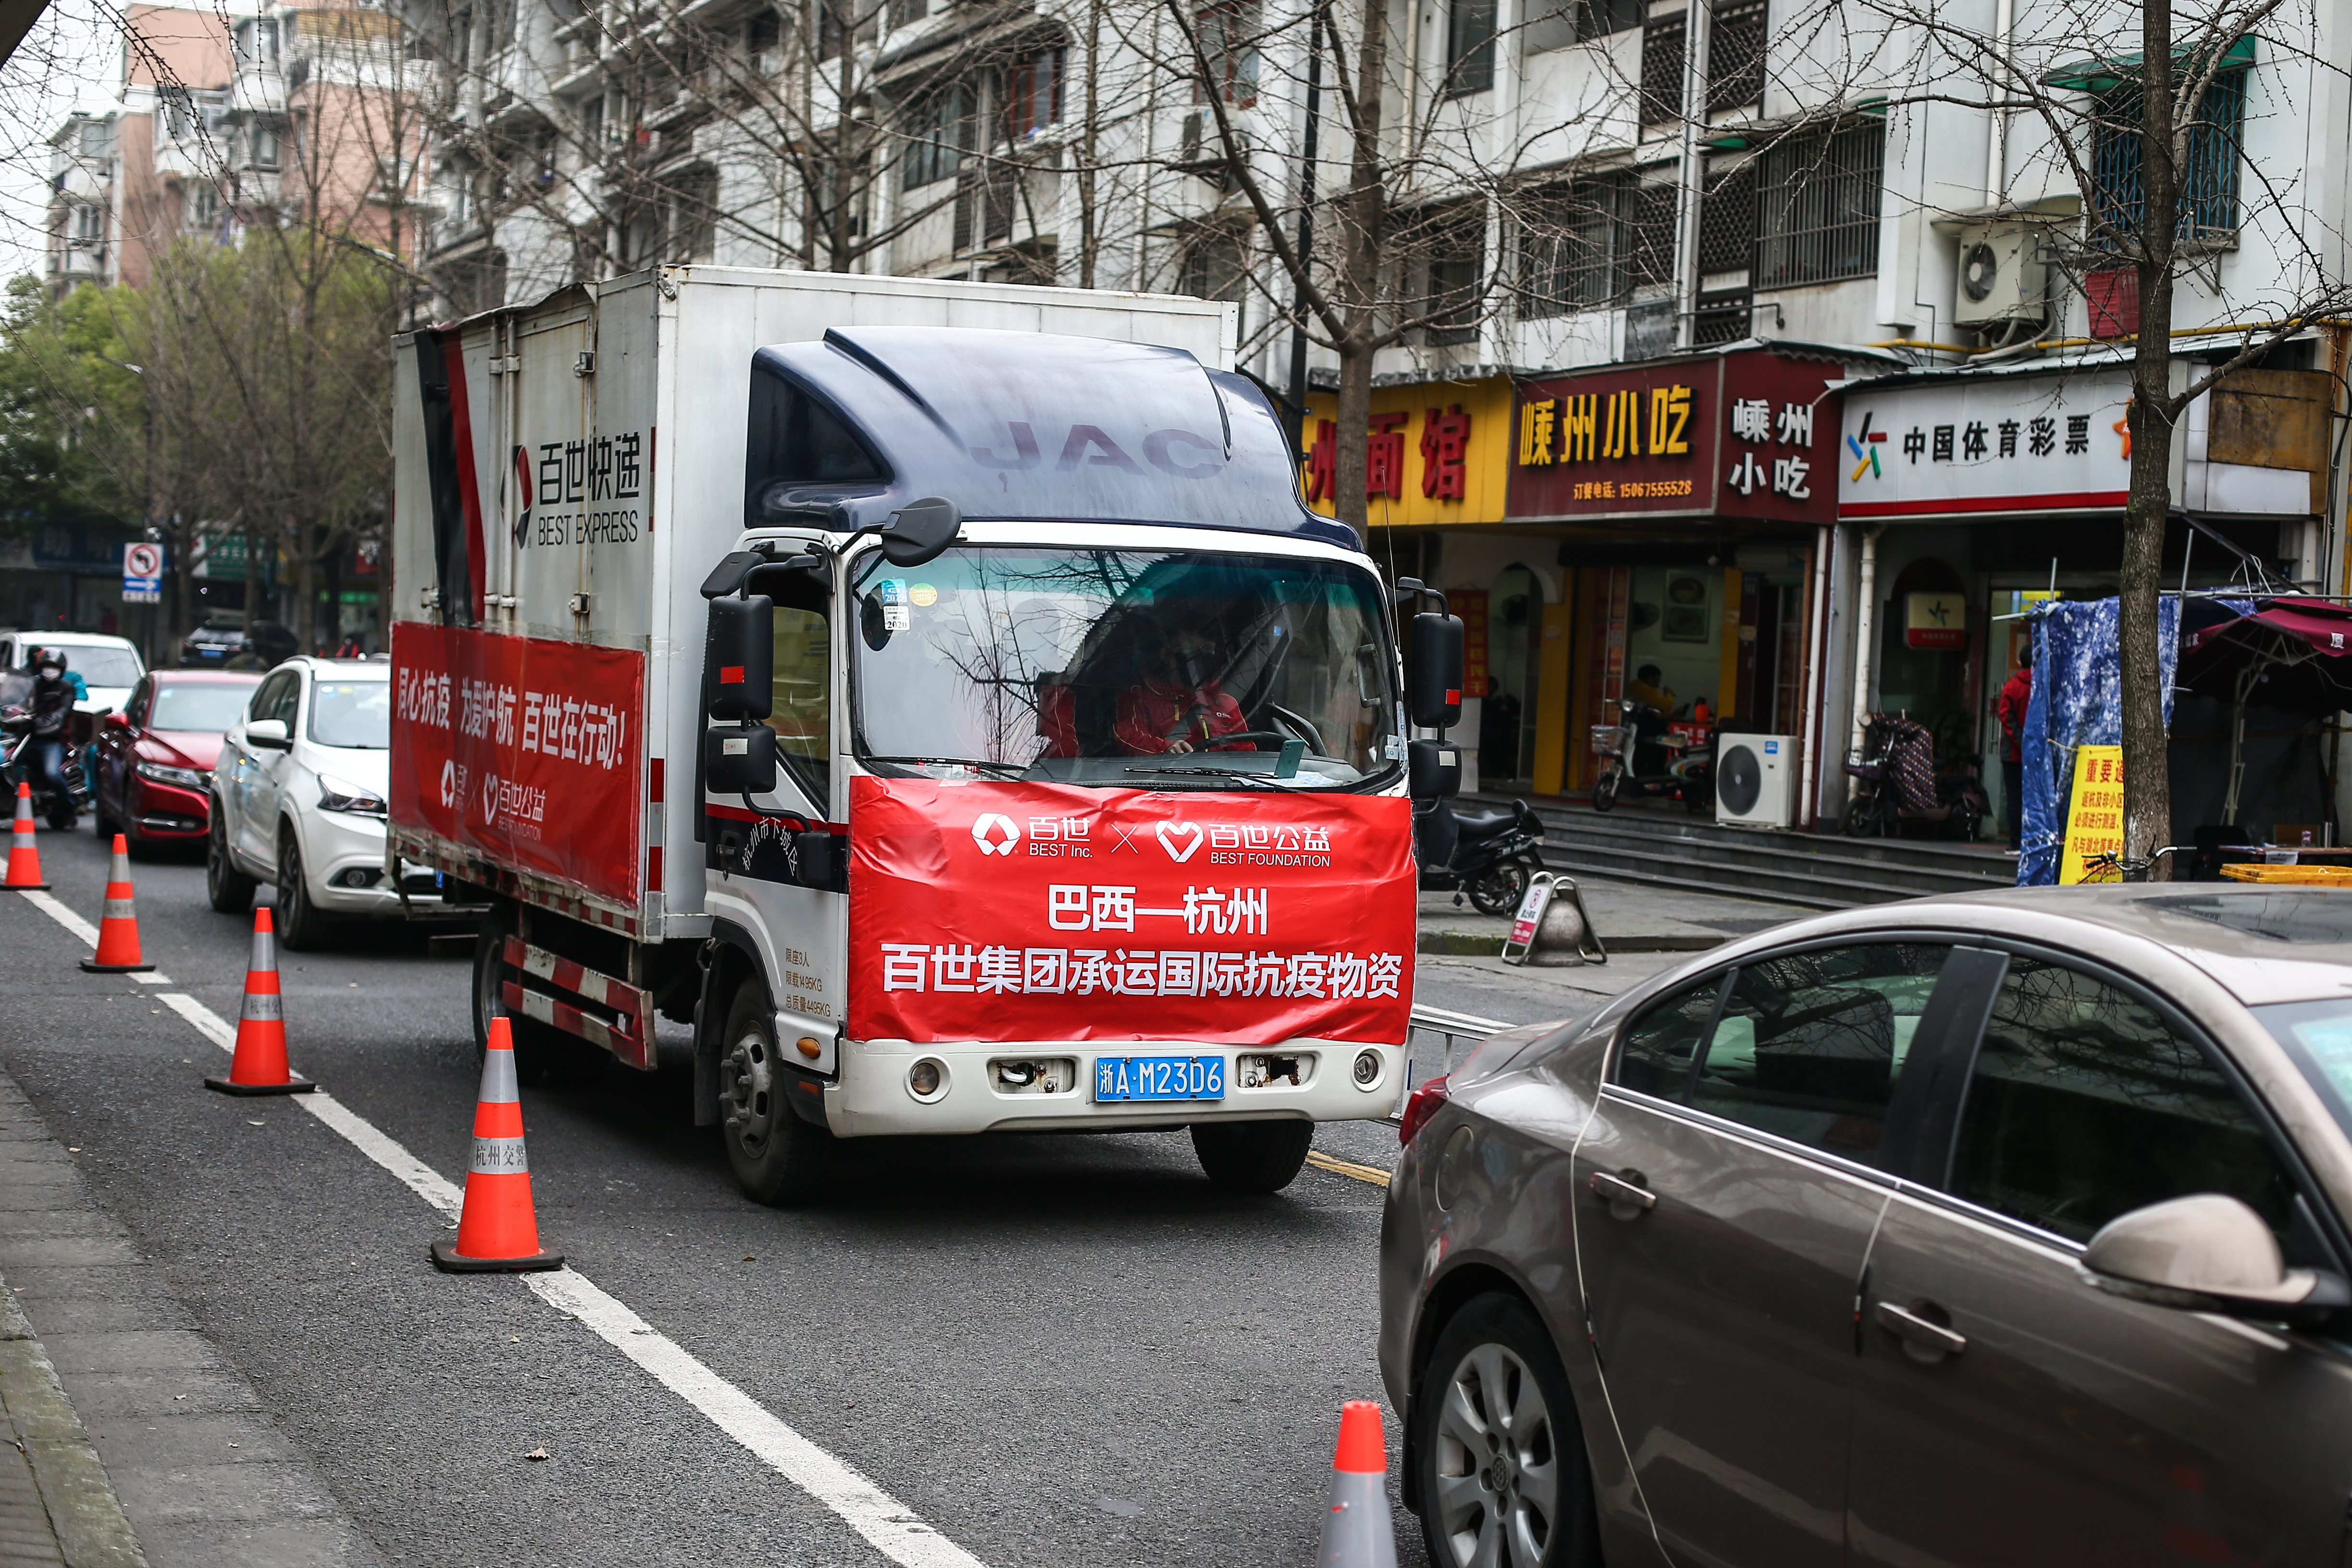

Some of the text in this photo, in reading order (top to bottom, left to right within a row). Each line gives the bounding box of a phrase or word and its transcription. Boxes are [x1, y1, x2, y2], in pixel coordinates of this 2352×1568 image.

[1519, 384, 1692, 466] 嵊州小吃
[1732, 398, 1813, 447] 嵊州
[969, 421, 1224, 480] JAC
[1903, 414, 2090, 465] 中国体育彩票
[539, 431, 640, 506] 百世快递
[1730, 452, 1810, 499] 小吃
[1620, 480, 1692, 498] 15067555528
[538, 510, 638, 546] BEST EXPRESS
[499, 779, 546, 822] 百世公益
[1028, 816, 1090, 842] 百世
[1208, 823, 1331, 851] 百世公益
[1029, 842, 1093, 858] BEST Inc.
[1211, 852, 1330, 867] BEST FOUNDATION
[786, 948, 809, 967] 限座3人
[881, 943, 1402, 999] 百世集团承运国际抗疫物资
[786, 971, 822, 992] 限载1495KG
[786, 994, 830, 1017] 总质量4495KG
[475, 1145, 524, 1166] 杭州交警
